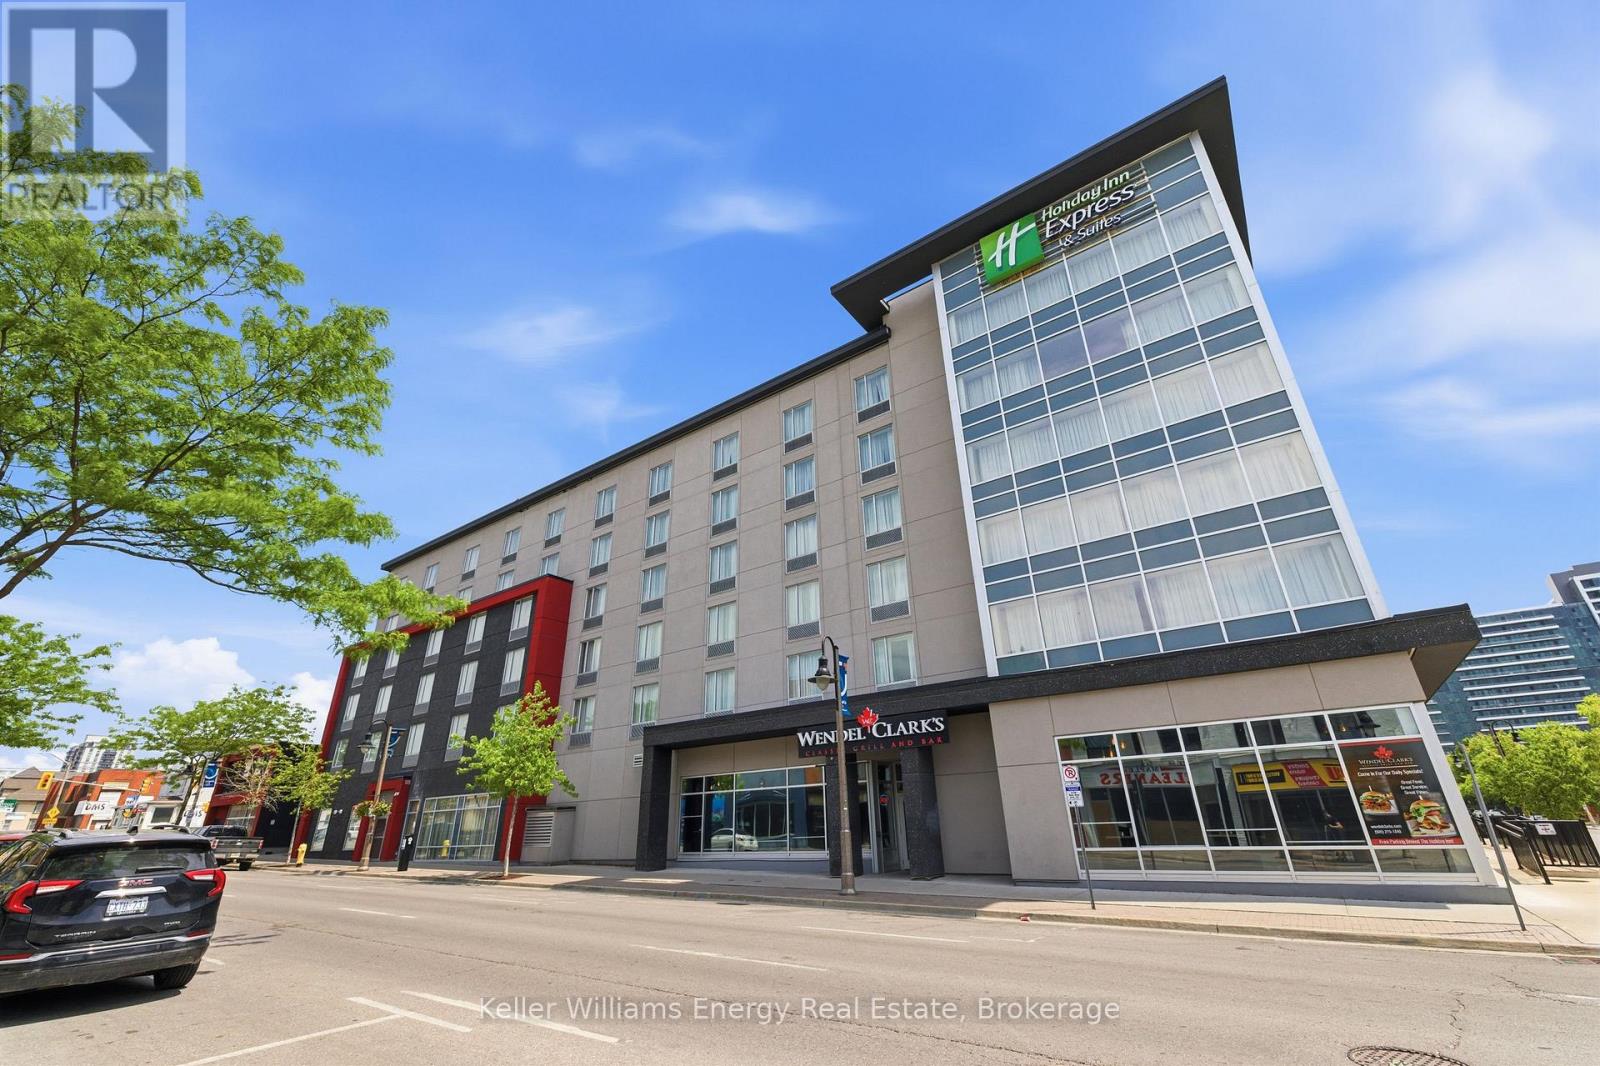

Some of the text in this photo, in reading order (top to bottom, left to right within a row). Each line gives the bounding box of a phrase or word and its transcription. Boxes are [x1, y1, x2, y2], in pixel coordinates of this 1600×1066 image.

[1041, 171, 1130, 222] Holiday Inn
[1045, 184, 1136, 239] Express
[1077, 213, 1122, 238] Suites
[872, 717, 945, 738] CLARK'S
[891, 740, 913, 749] AND
[921, 736, 943, 746] BAR
